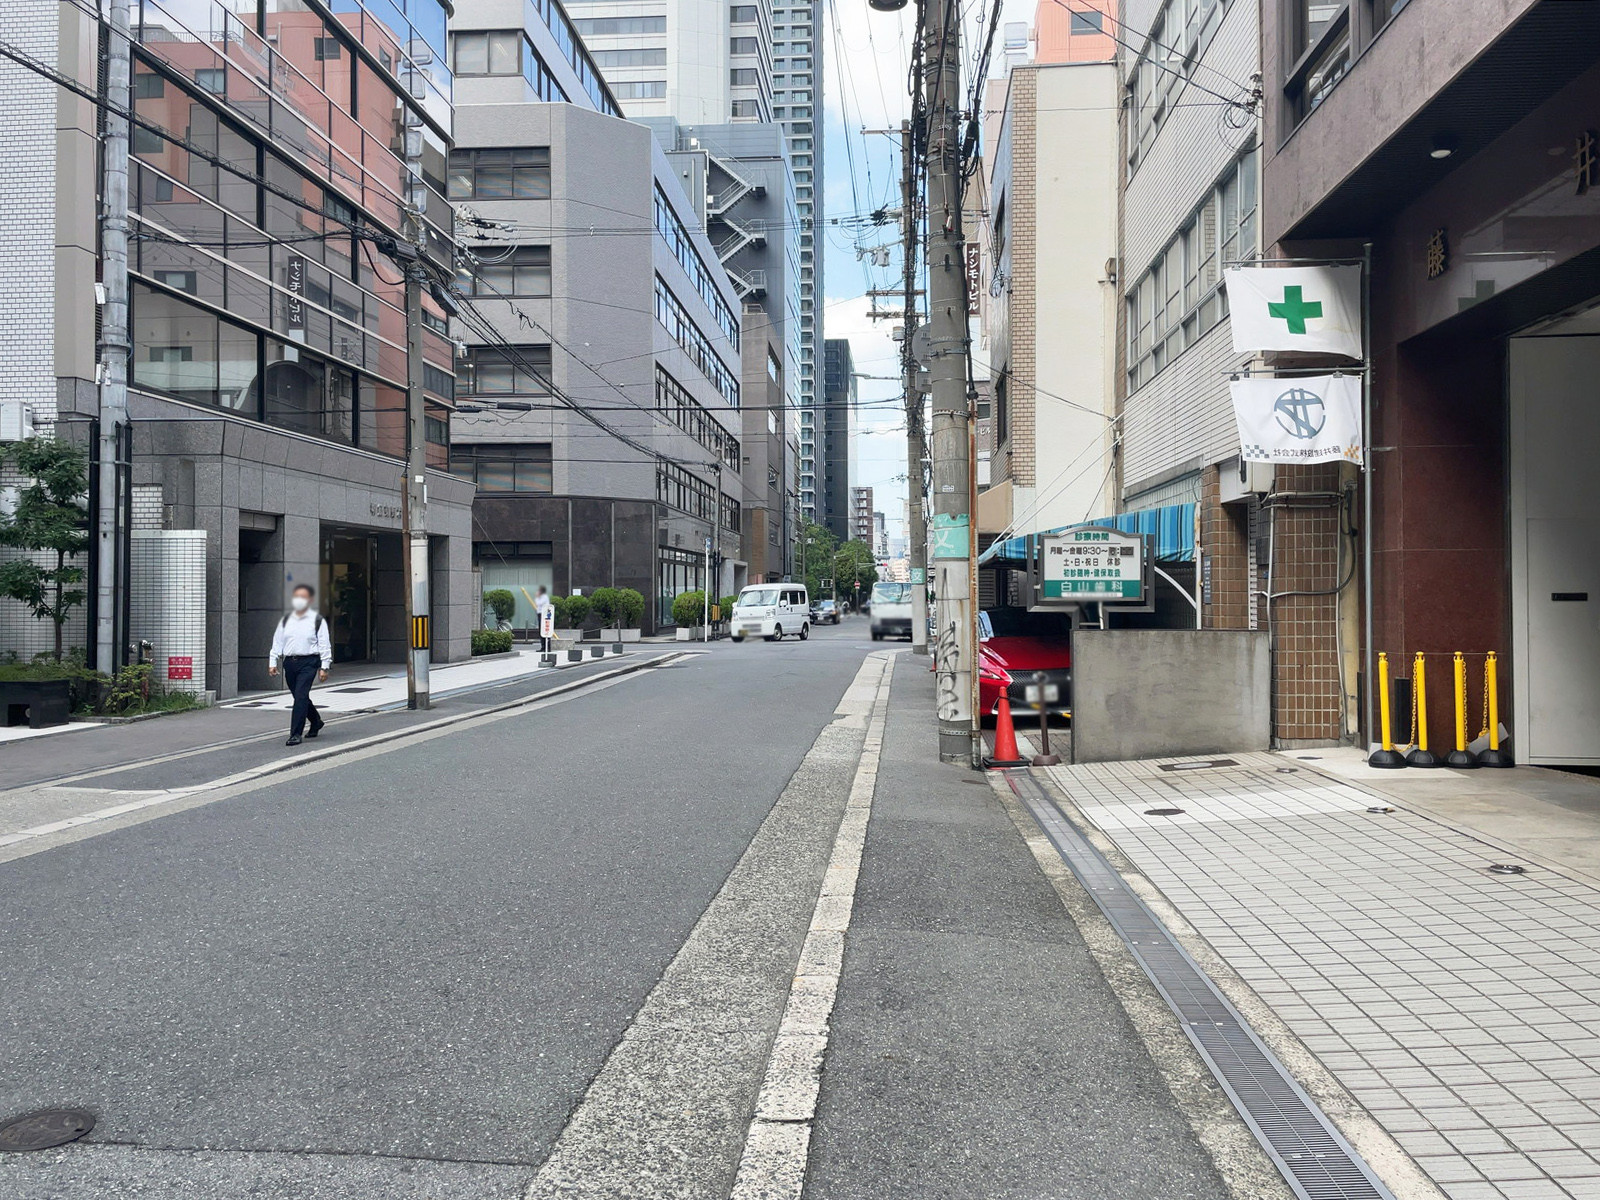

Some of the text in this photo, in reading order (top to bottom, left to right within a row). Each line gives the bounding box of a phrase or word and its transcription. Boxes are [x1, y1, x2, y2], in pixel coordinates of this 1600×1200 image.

[968, 247, 979, 311] ナシモトビル
[1075, 532, 1109, 541] 診療時間
[1061, 581, 1123, 592] 白山歯科
